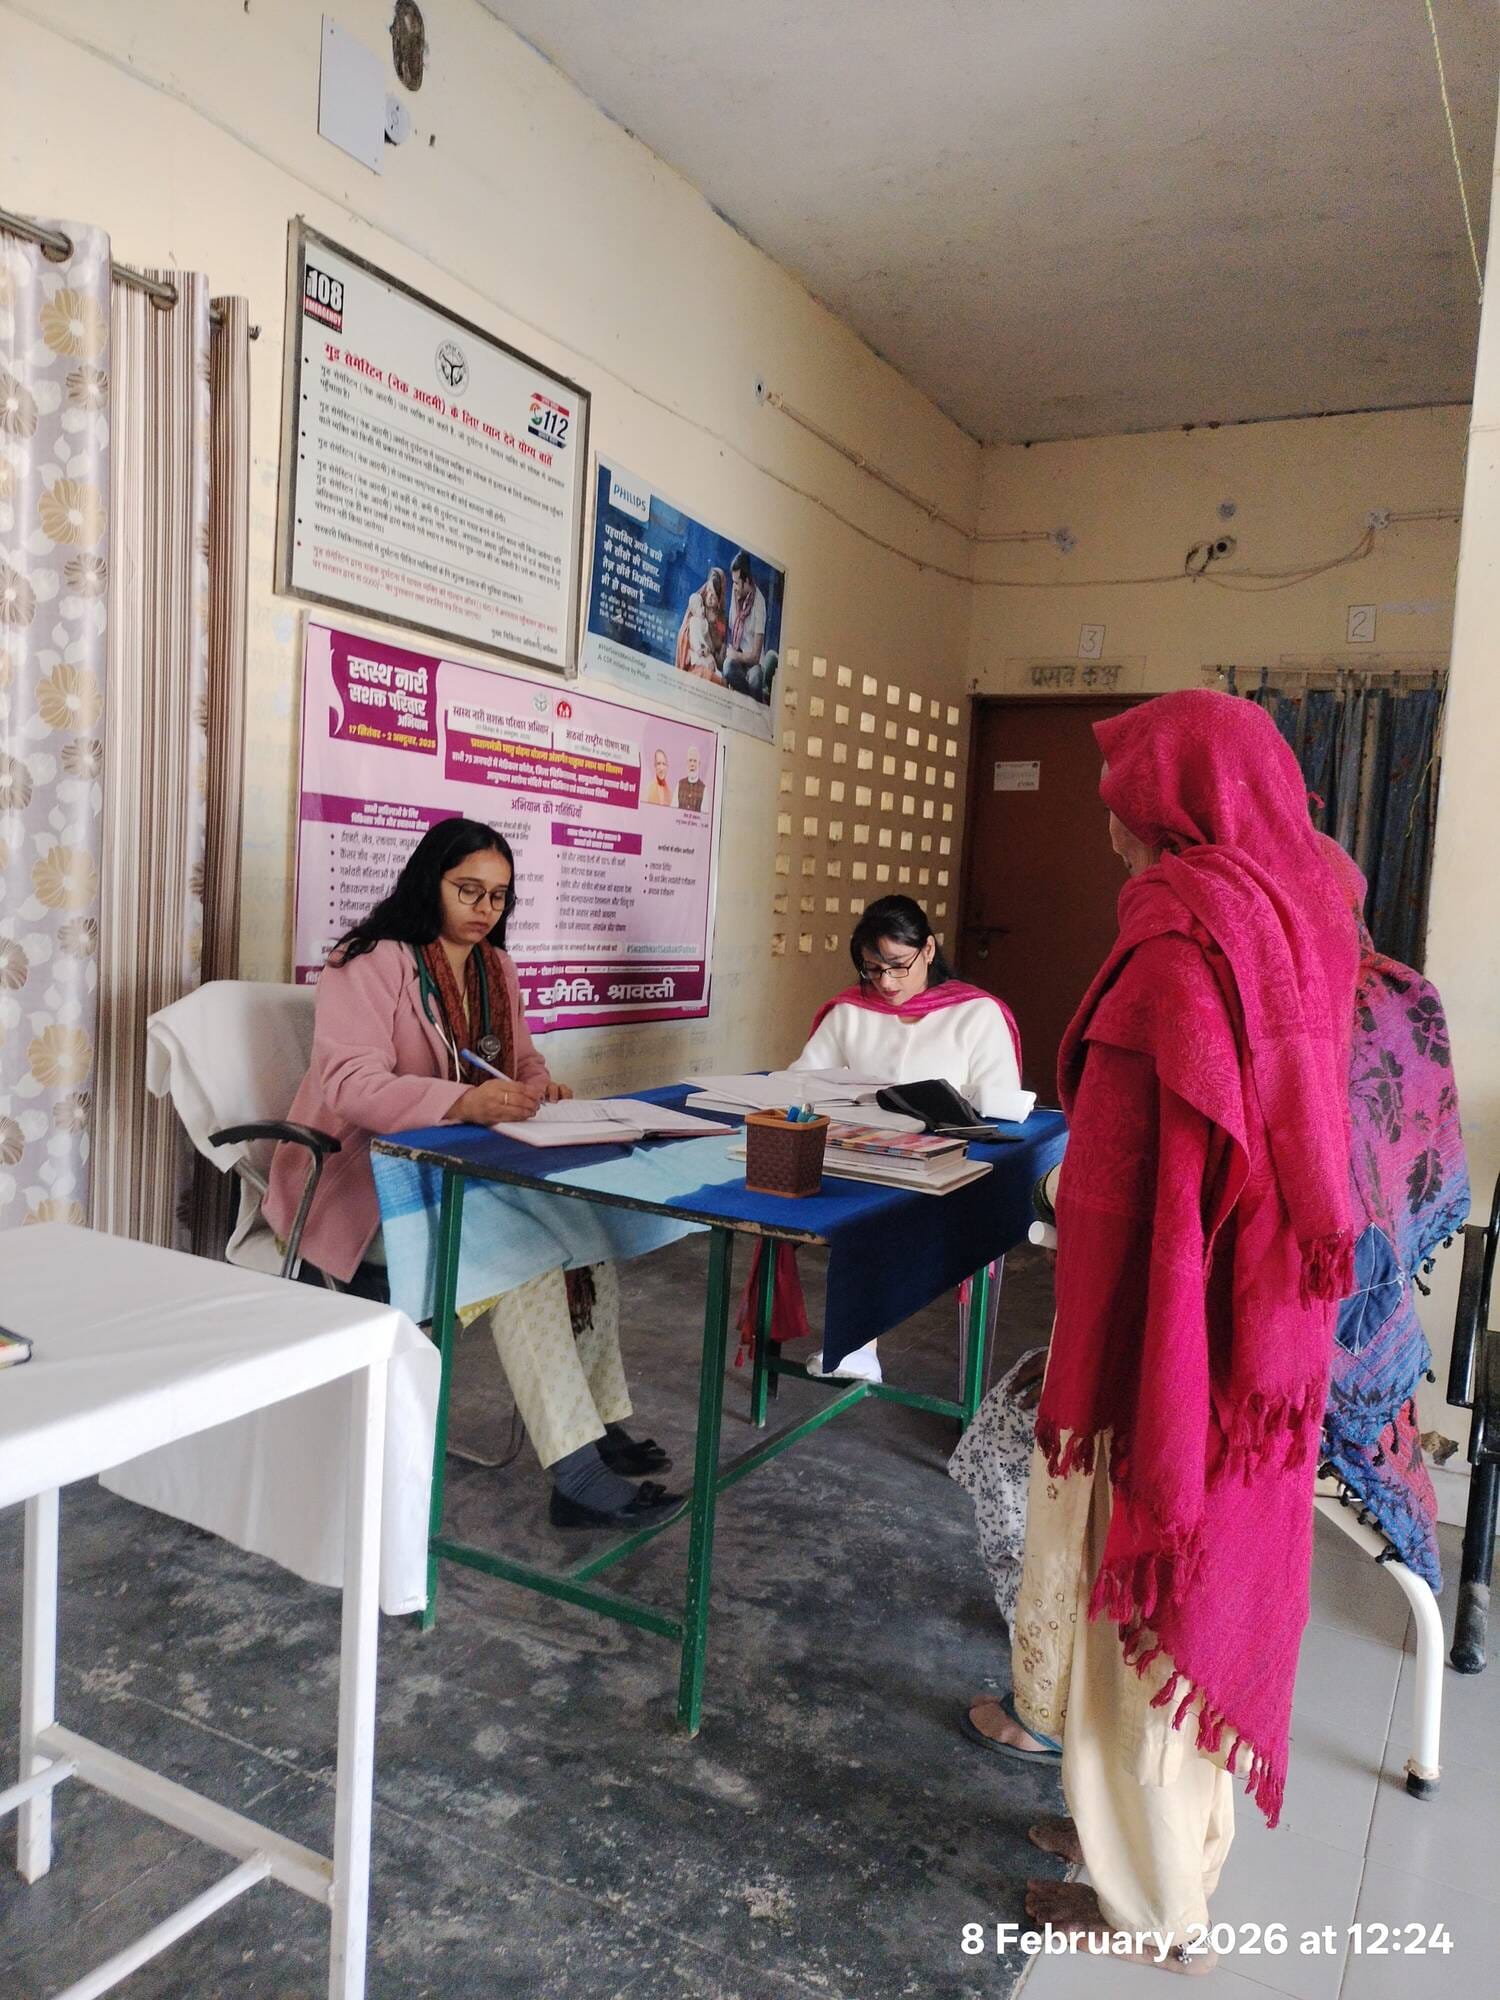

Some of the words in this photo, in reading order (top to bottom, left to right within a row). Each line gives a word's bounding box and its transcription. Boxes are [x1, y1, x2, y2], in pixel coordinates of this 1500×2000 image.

[307, 271, 342, 310] 108
[305, 299, 341, 325] EMERGENCY
[544, 410, 568, 439] 112
[503, 432, 515, 448] देने
[613, 484, 646, 511] PHILIPS
[1352, 610, 1368, 638] 2
[1081, 630, 1097, 653] 3
[348, 656, 392, 685] स्वस्थ
[394, 667, 427, 694] नारी
[349, 683, 386, 706] सशक्त
[388, 689, 426, 716] परिवार
[398, 713, 428, 730] अभियान
[453, 706, 471, 718] स्वस्थ
[472, 708, 485, 721] नारी
[505, 716, 526, 729] परिवार
[528, 720, 549, 734] अभियान
[511, 797, 540, 812] अभियान
[542, 800, 553, 814] की
[608, 977, 674, 999] श्रावस्ती
